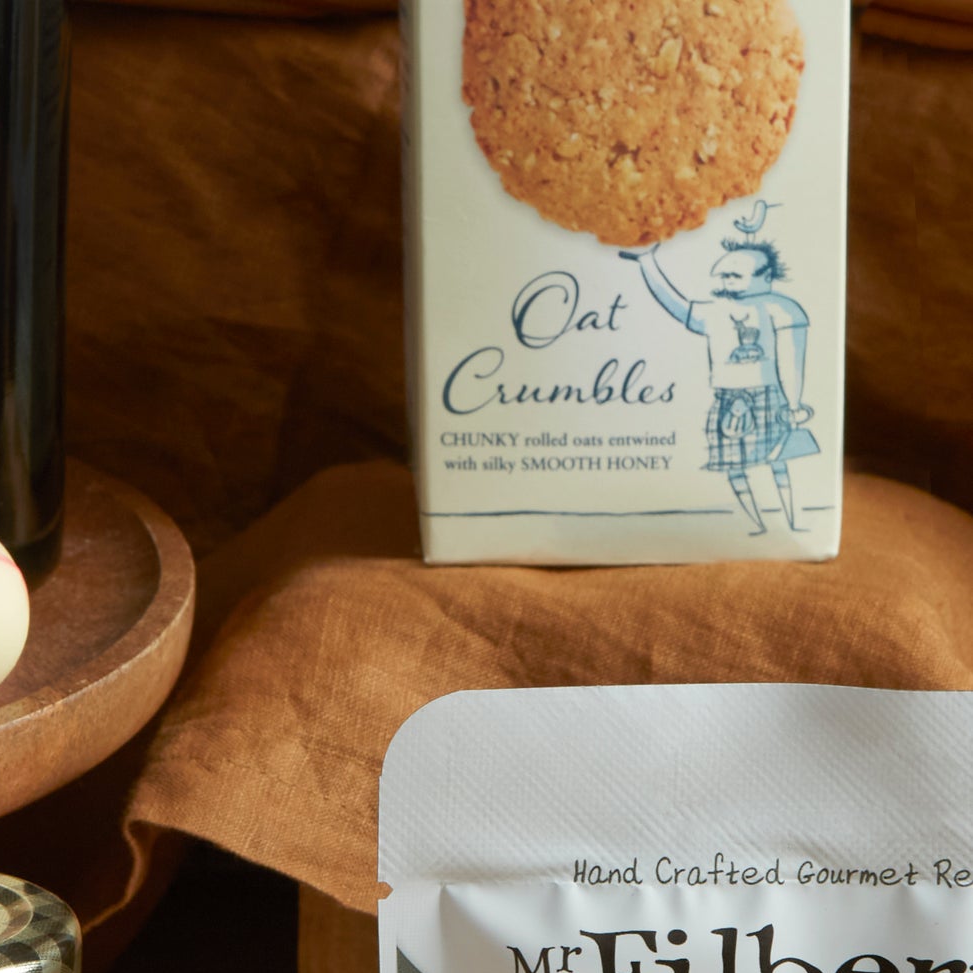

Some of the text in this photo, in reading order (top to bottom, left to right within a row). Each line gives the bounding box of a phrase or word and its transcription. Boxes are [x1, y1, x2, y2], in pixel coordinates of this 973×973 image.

[512, 270, 628, 349] Oat
[442, 346, 675, 415] Crumbles
[440, 431, 676, 447] CHUNKY rolled oats entwined
[444, 456, 672, 472] with silky SMOOTH HONEY
[573, 852, 973, 889] Hand Crafted Gourmet Re
